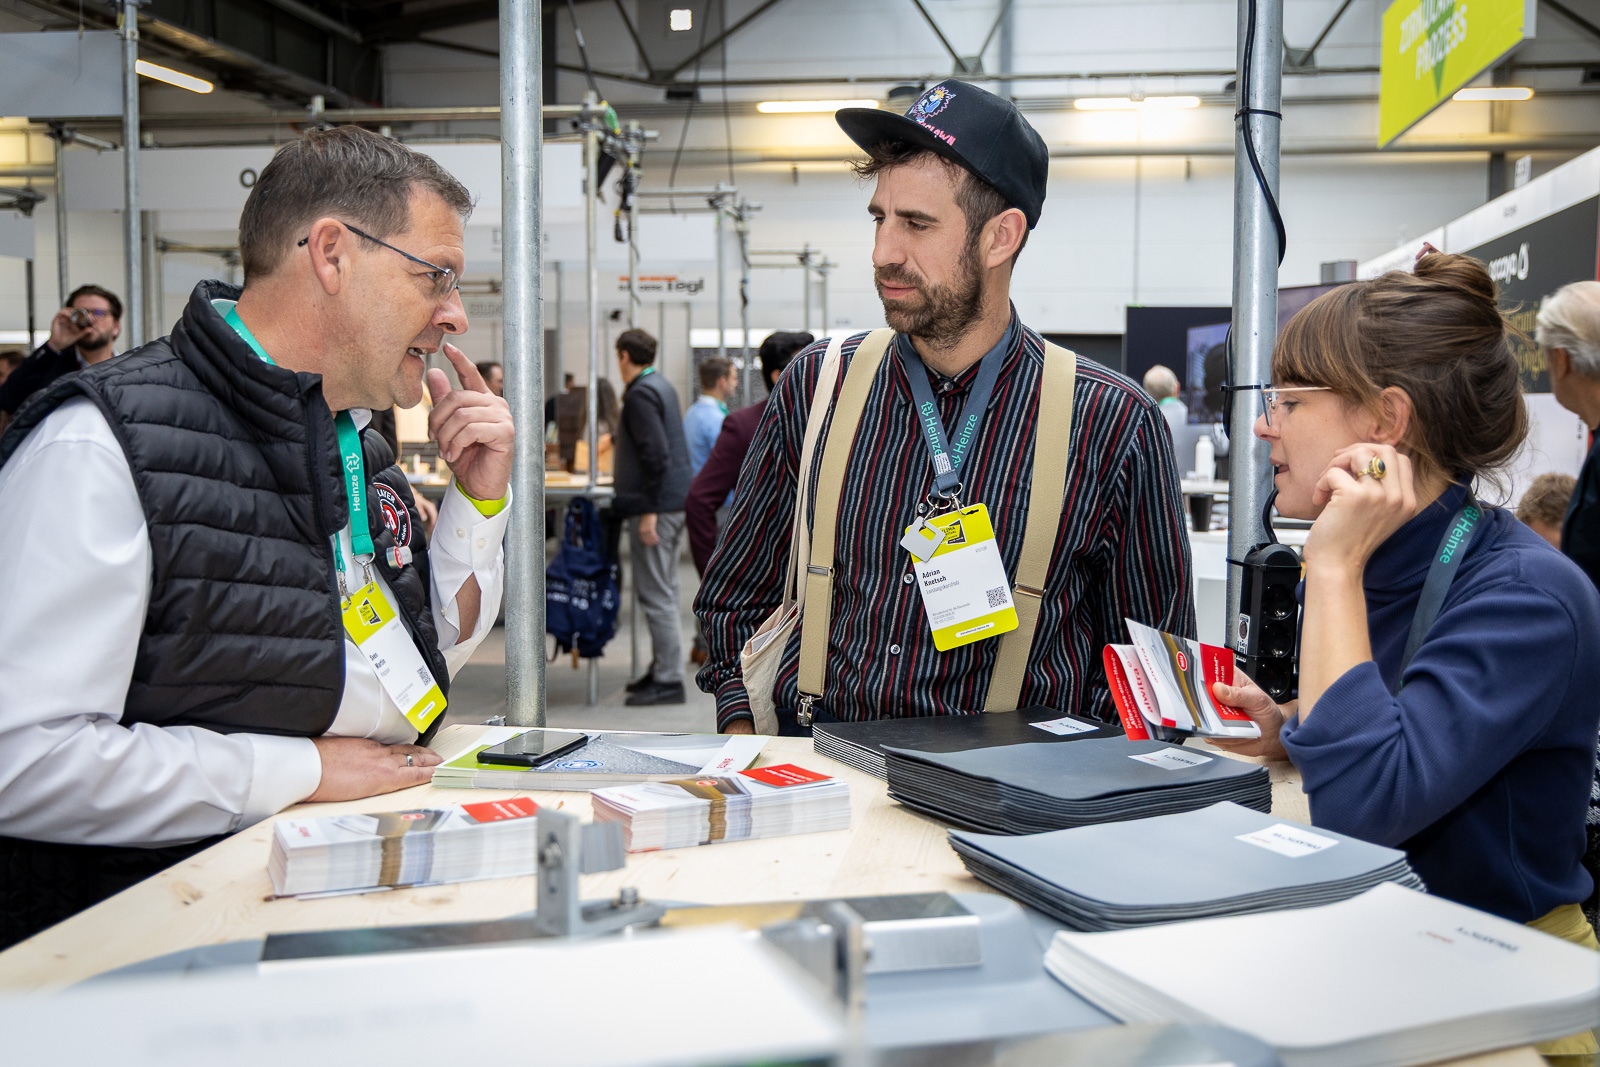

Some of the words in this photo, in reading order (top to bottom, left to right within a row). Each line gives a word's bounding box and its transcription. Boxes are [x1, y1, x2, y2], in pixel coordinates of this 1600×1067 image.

[924, 416, 943, 456] Heinze
[953, 414, 978, 454] Heinze
[351, 474, 361, 512] Heinze
[1440, 517, 1473, 564] Heinze
[922, 569, 941, 579] Adrian
[923, 576, 947, 587] Knetsch
[1134, 668, 1153, 714] alwitra
